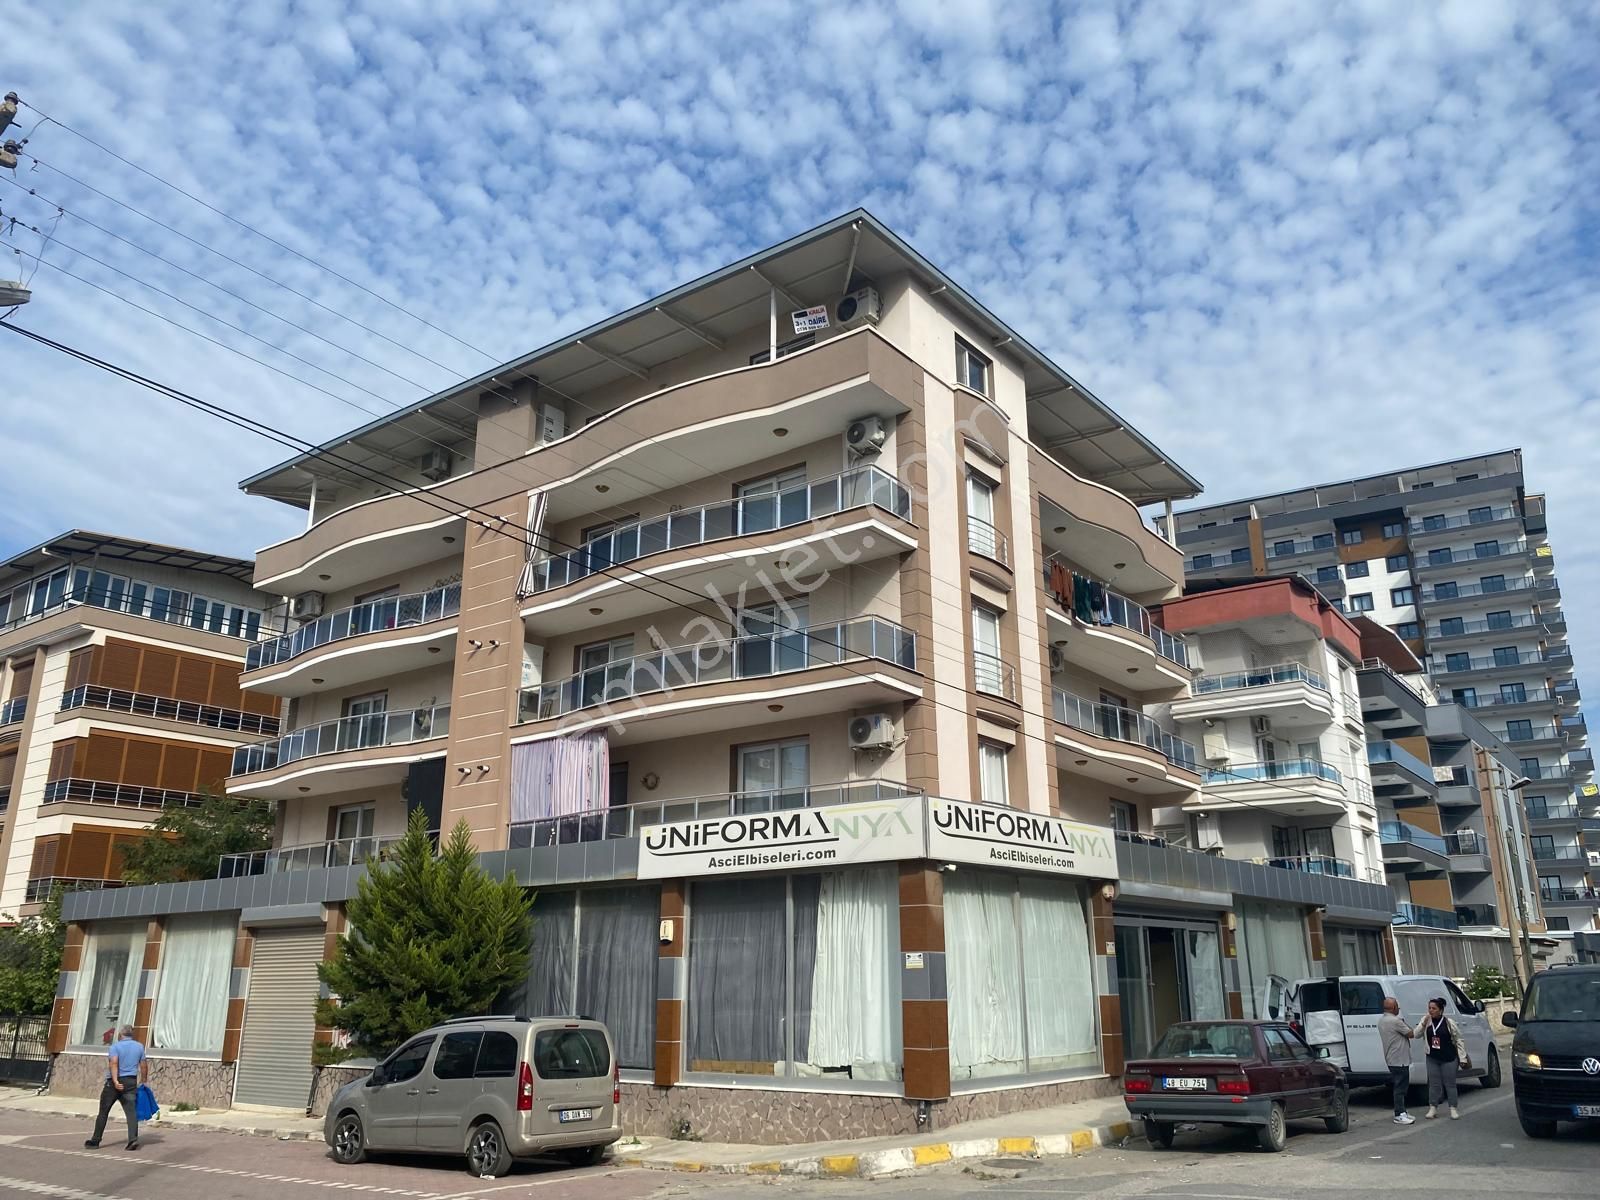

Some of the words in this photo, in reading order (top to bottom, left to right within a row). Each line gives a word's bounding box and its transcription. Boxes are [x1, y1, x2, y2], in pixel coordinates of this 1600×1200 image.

[708, 849, 836, 868] AsciElbiseleri.com
[990, 848, 1075, 868] AsciElbiseleri.com
[1180, 1079, 1188, 1087] EU
